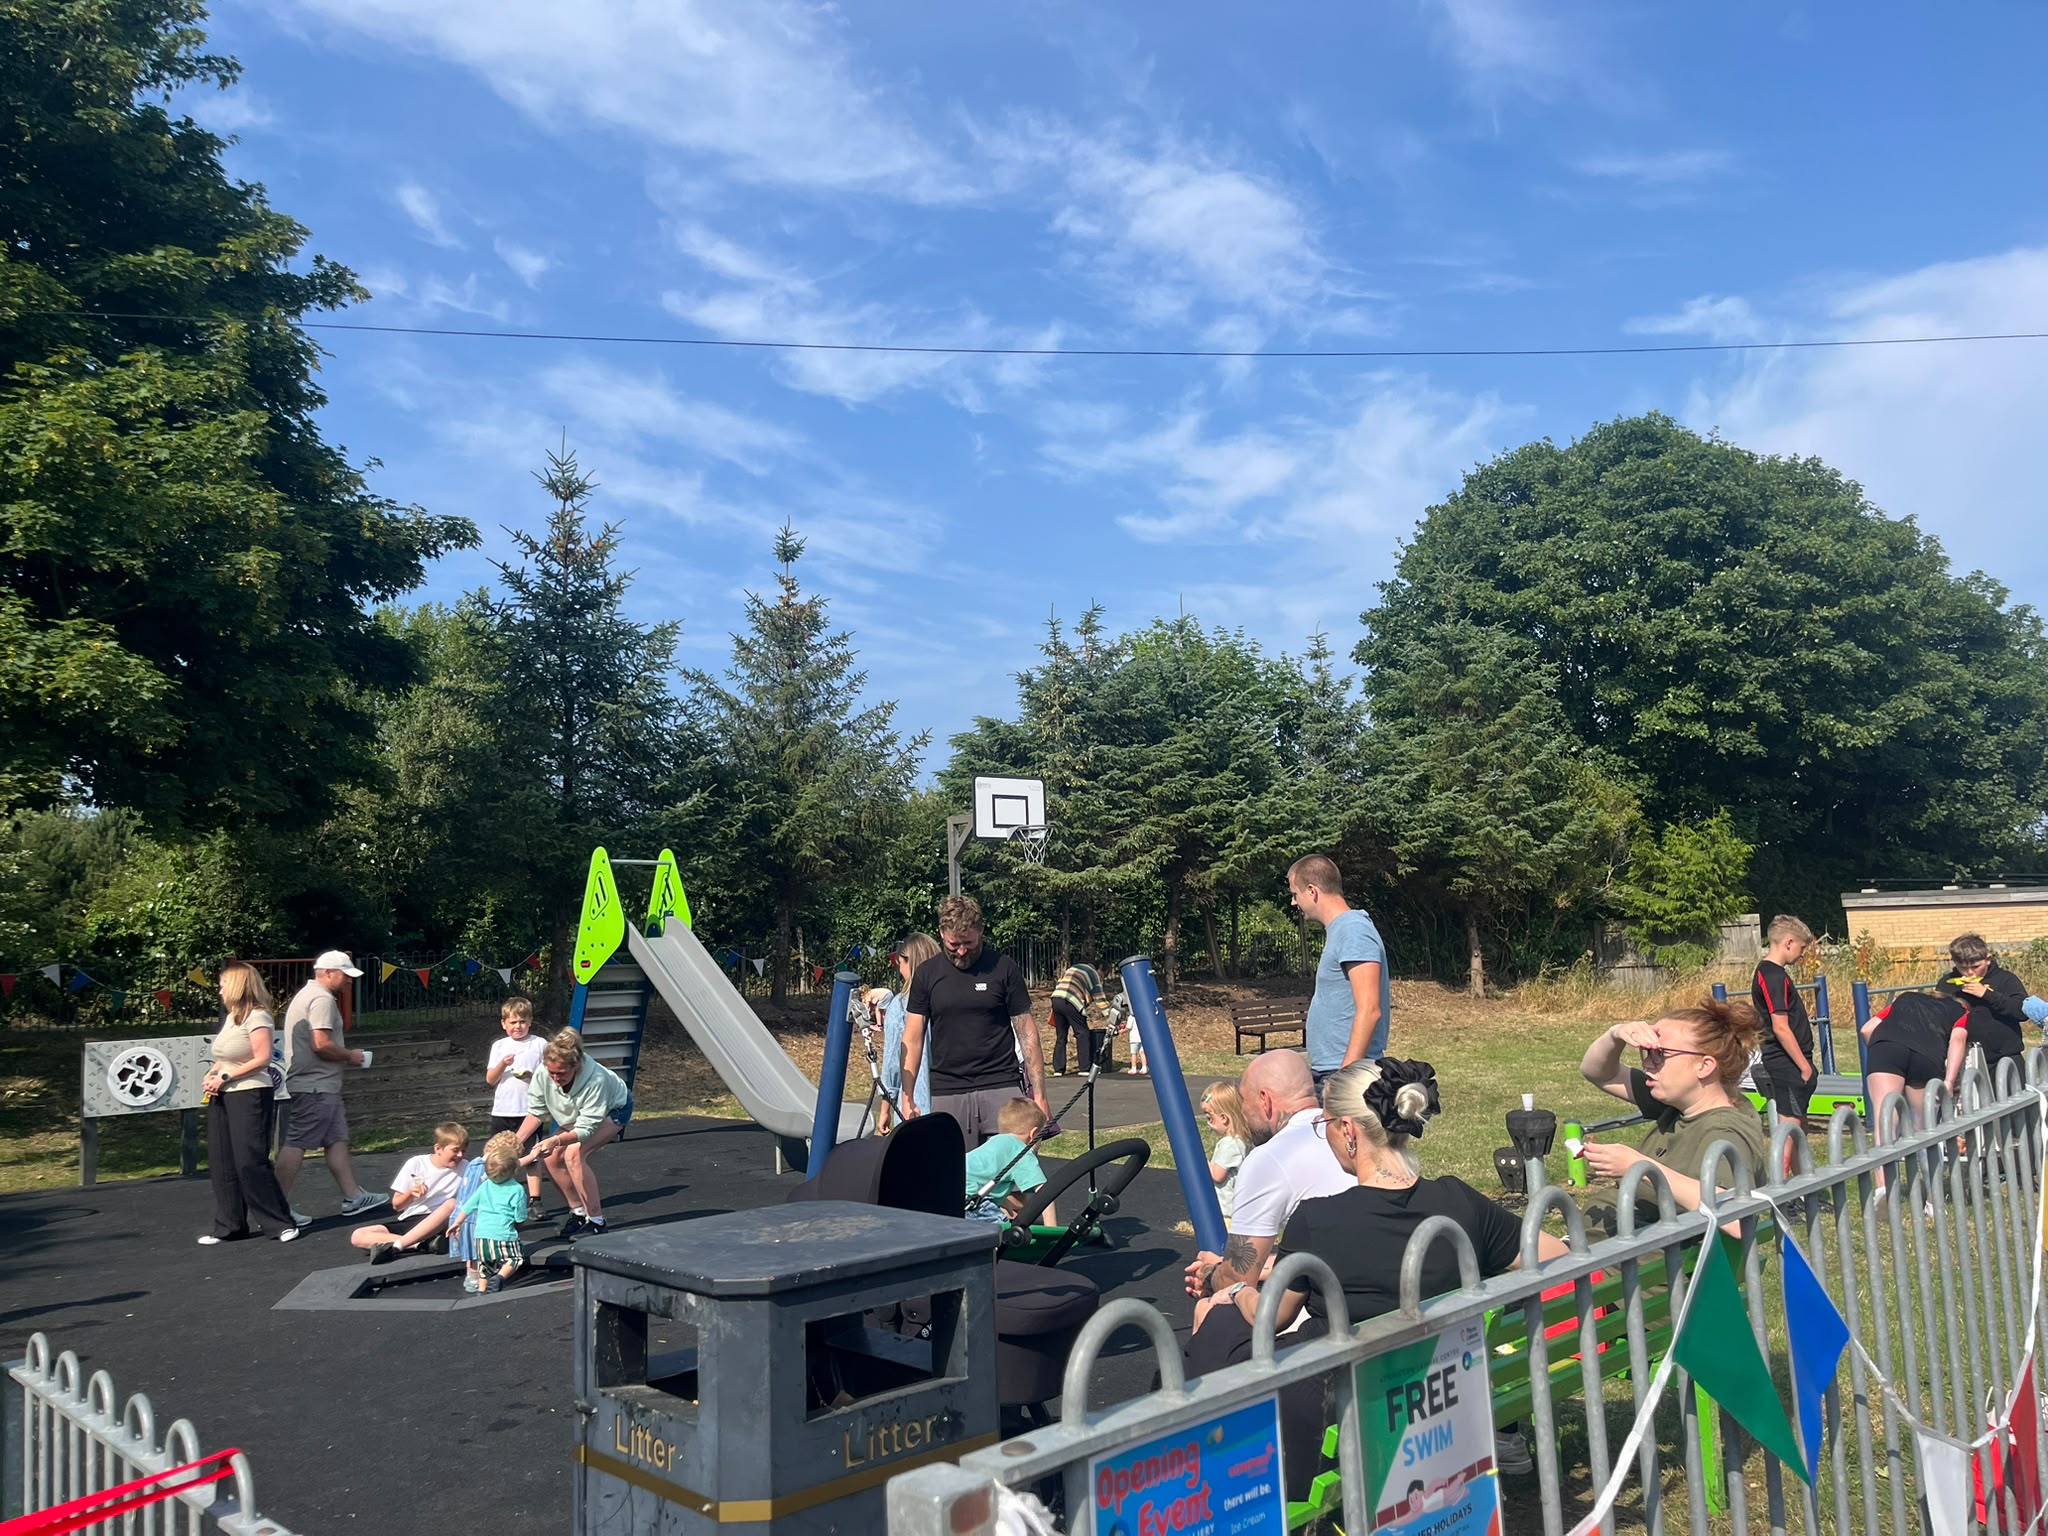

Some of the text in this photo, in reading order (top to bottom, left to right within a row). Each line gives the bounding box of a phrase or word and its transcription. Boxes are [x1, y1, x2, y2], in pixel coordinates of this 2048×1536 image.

[1385, 1364, 1459, 1433] FREE
[616, 1413, 677, 1473] Litter
[843, 1414, 939, 1469] Litter
[1402, 1419, 1454, 1468] SWIM
[1096, 1440, 1201, 1517] Opening
[1223, 1495, 1244, 1512] there
[1245, 1485, 1259, 1502] will
[1138, 1479, 1214, 1536] Event
[1230, 1511, 1266, 1535] Ice Cream
[1434, 1501, 1473, 1535] HOLIDAYS
